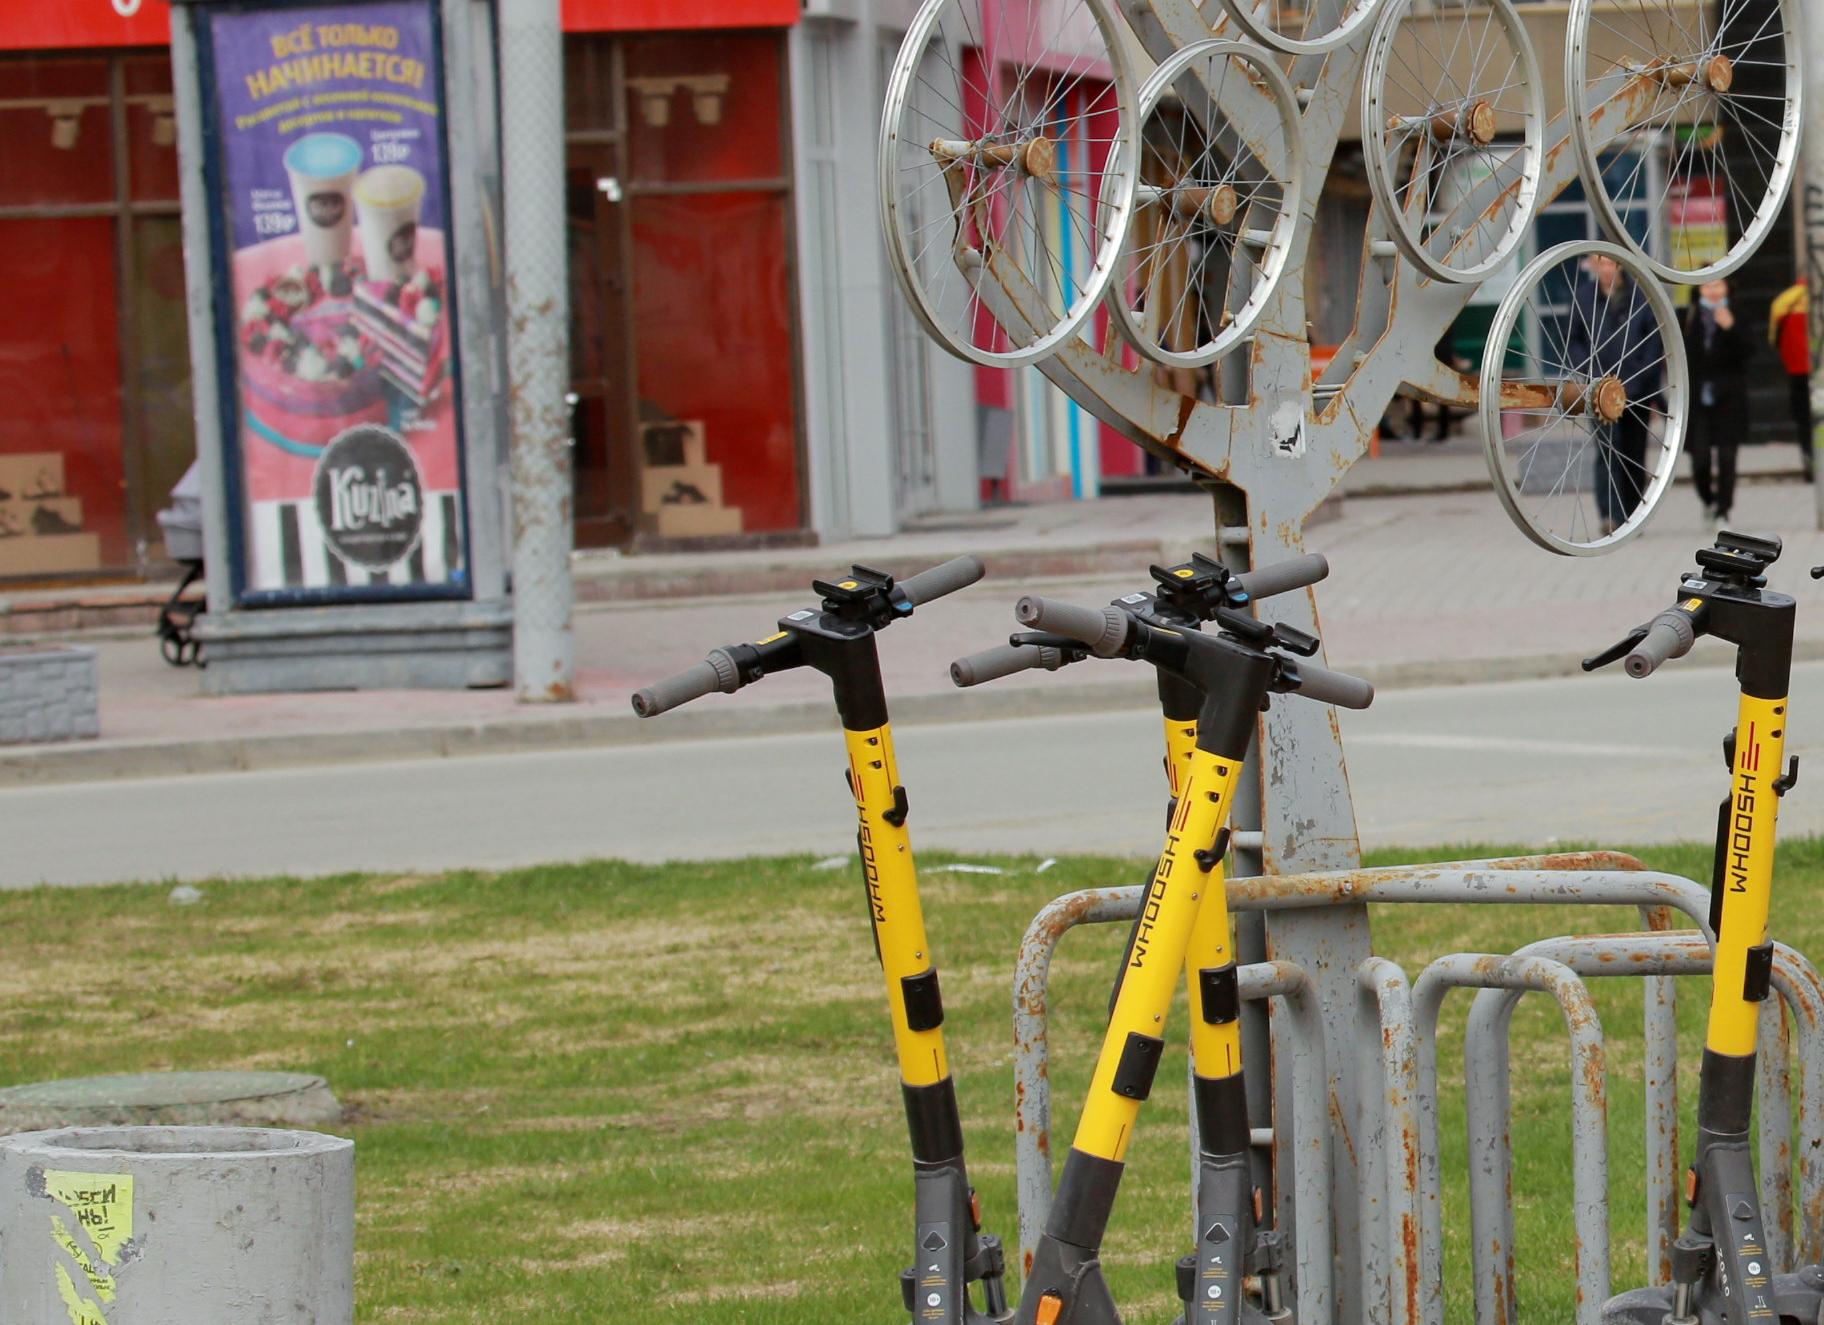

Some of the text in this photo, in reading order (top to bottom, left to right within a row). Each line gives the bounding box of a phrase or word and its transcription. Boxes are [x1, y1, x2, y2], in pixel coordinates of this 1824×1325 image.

[246, 52, 426, 100] НАЧИНАЕТСЯ!
[317, 23, 399, 50] ТОЛЬКО
[329, 465, 418, 531] Kuzina
[857, 804, 887, 923] WHOOSH
[1729, 773, 1757, 893] WHOOSH
[1130, 834, 1181, 969] WHOOSH
